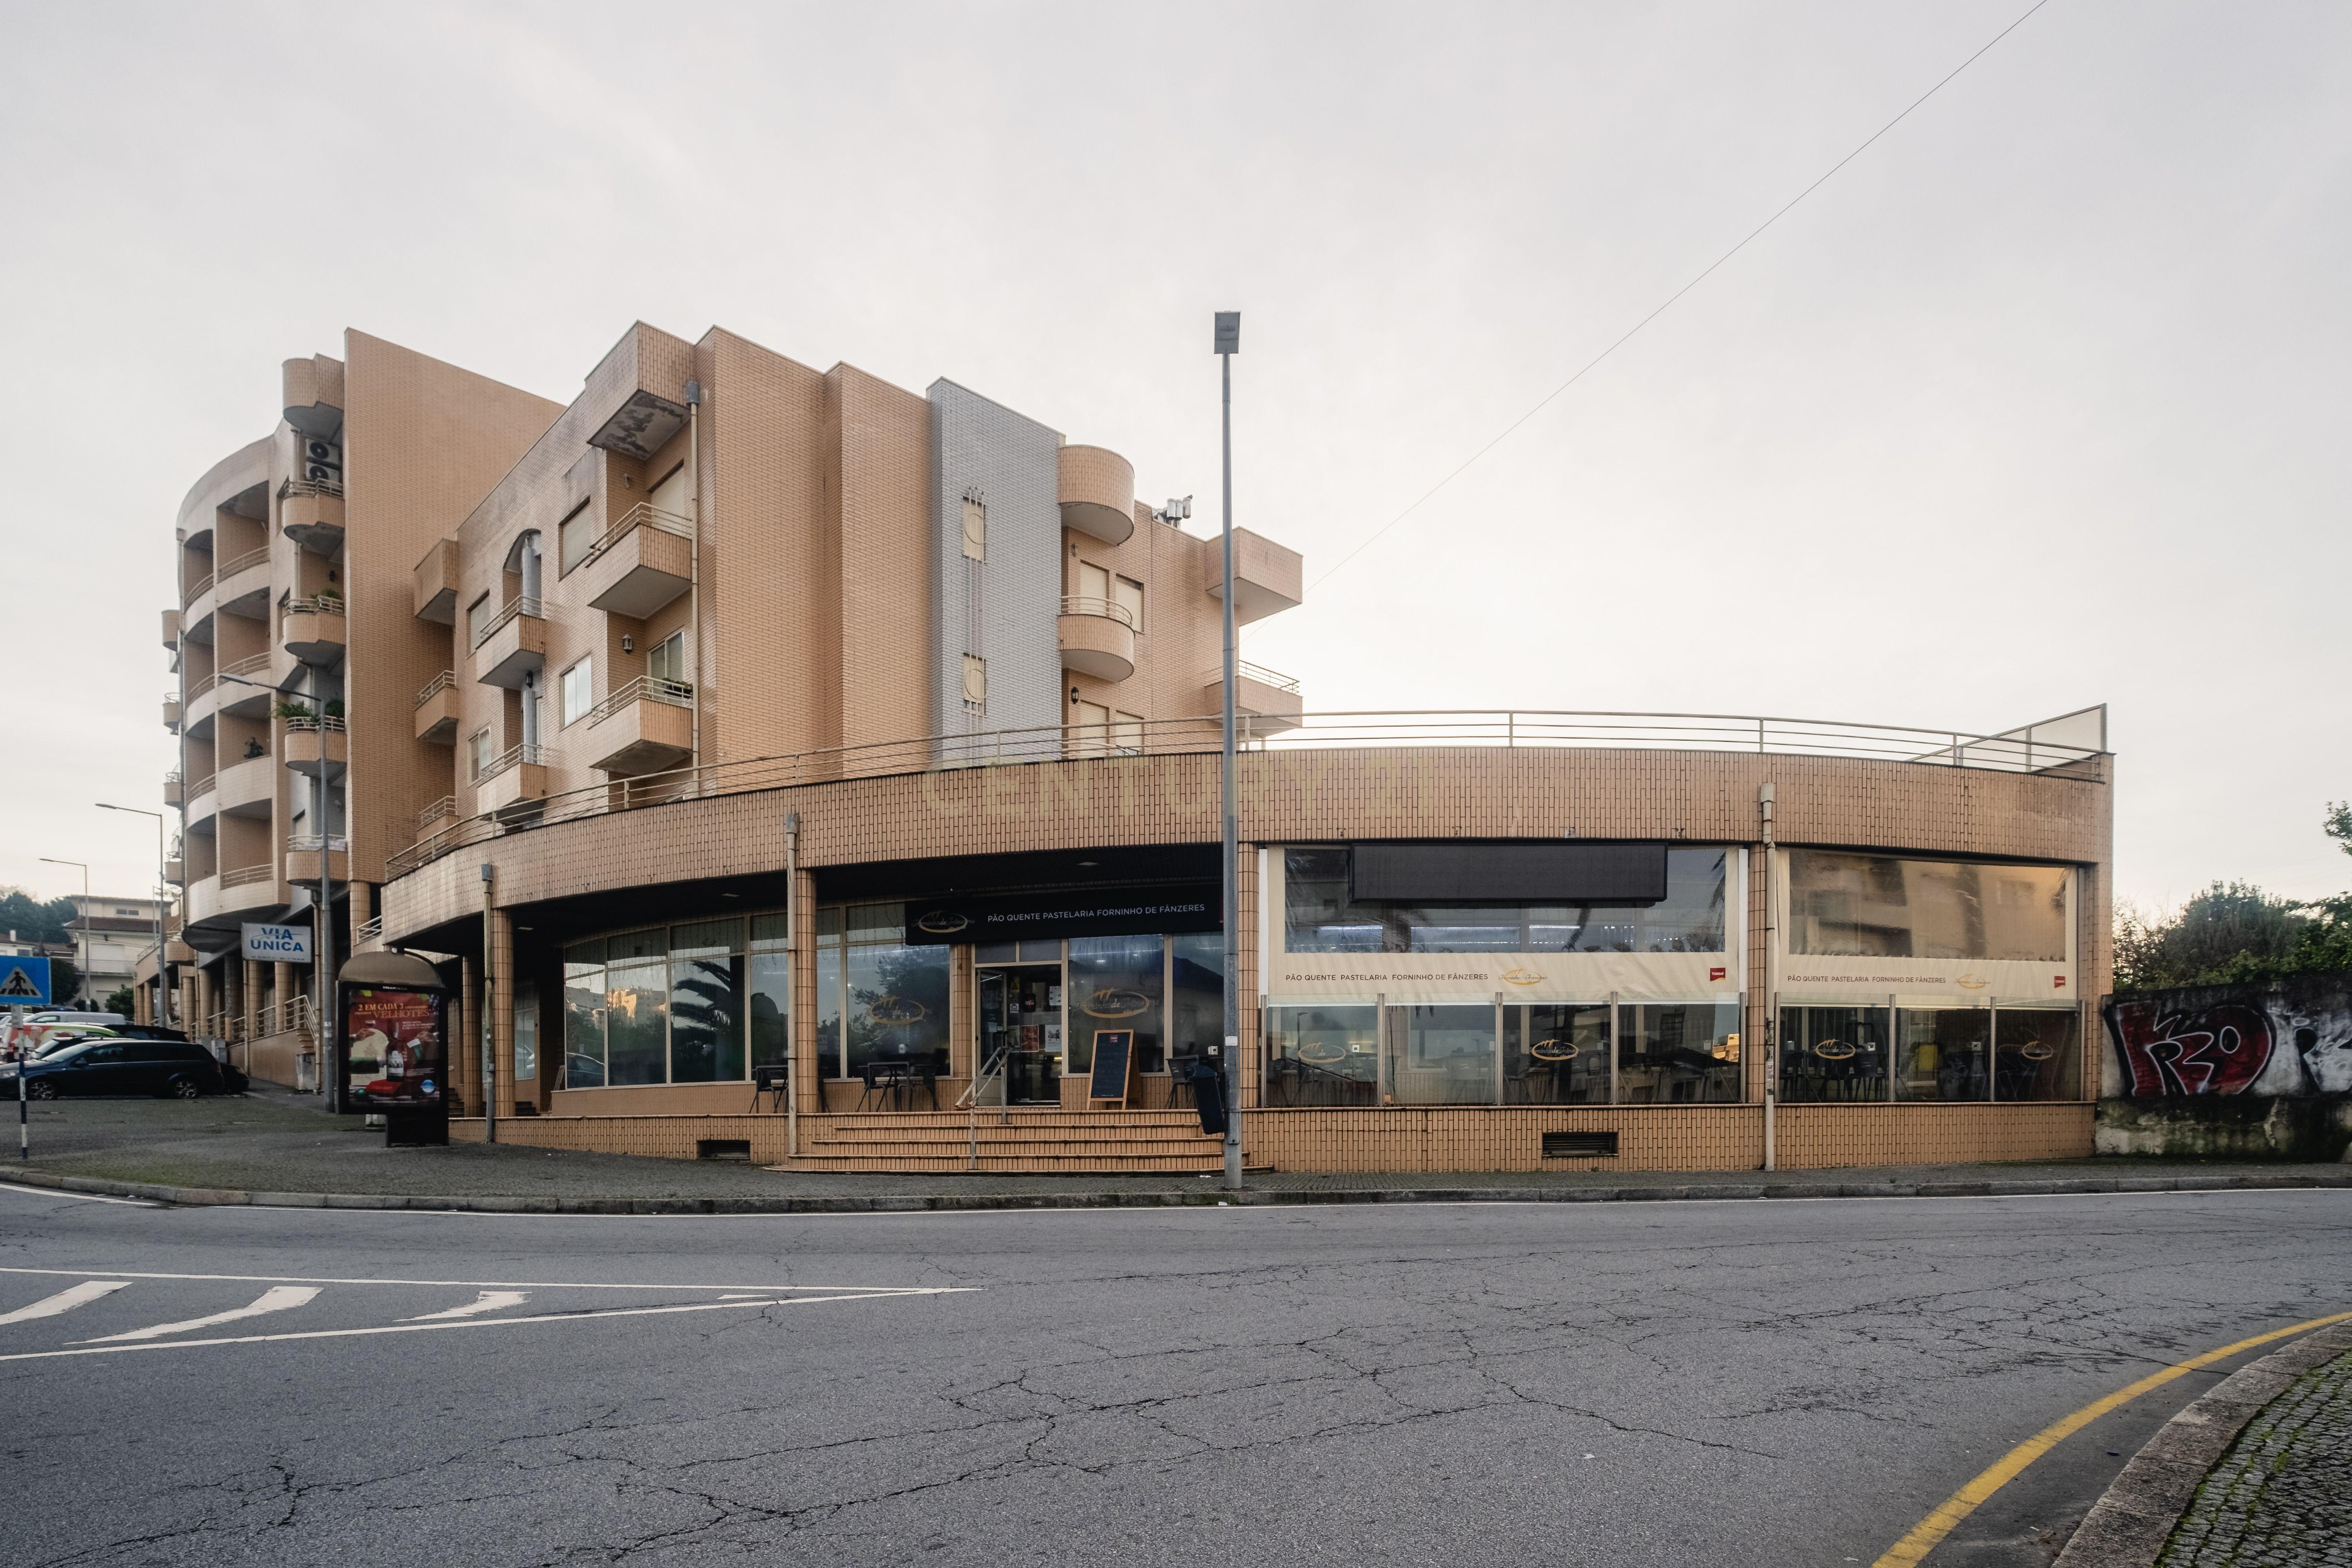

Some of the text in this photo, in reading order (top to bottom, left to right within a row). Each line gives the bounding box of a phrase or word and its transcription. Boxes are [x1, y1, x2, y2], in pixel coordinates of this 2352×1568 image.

[988, 913, 1004, 922] PÃO
[1007, 913, 1040, 921] QUENTE
[1043, 910, 1094, 919] PASTELARIA
[1097, 907, 1142, 916] FORNINHO
[1160, 904, 1205, 913] FÂNZERES
[261, 927, 293, 940] VIA
[251, 940, 304, 952] UNICA
[372, 1009, 430, 1018] VELHOTES
